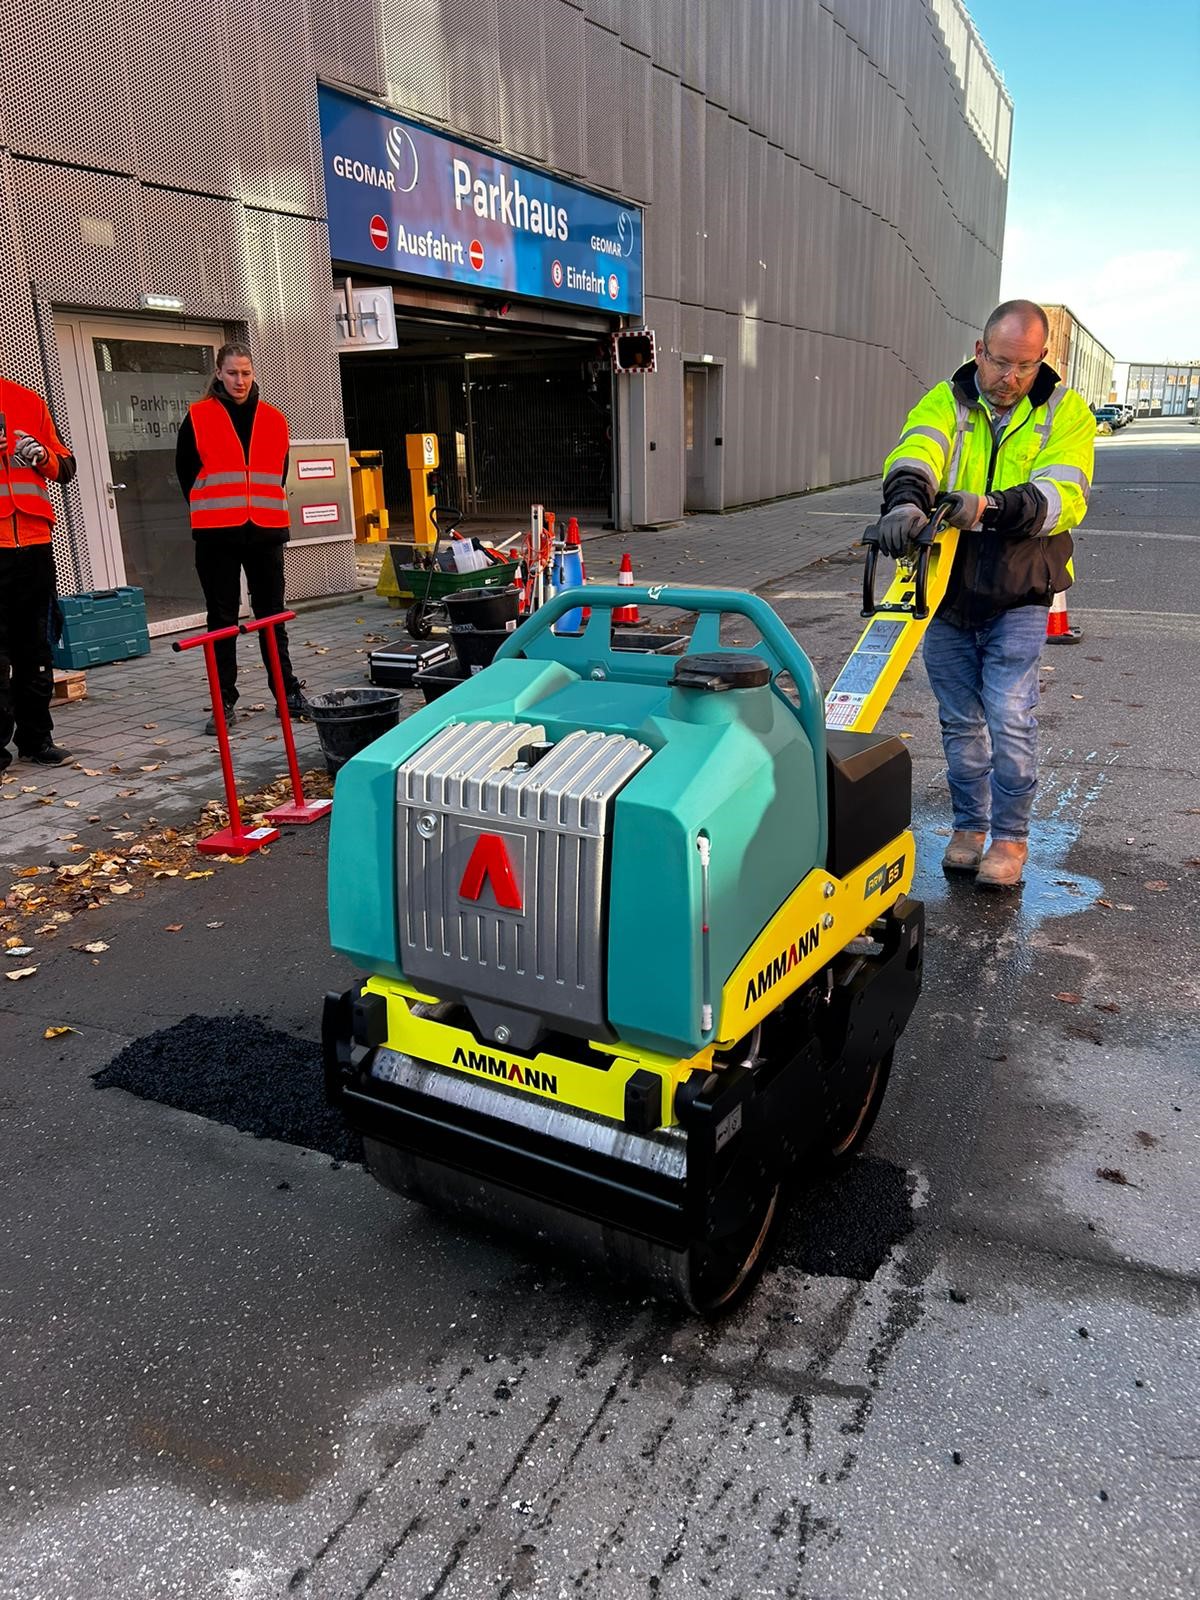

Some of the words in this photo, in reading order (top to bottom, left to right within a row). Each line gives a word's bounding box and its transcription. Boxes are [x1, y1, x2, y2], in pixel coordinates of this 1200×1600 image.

[333, 155, 397, 192] GEOMAR
[452, 158, 569, 241] Parkhaus
[397, 224, 464, 265] Ausfahrt
[590, 235, 622, 258] GEOMAR
[566, 265, 606, 295] Einfahrt
[888, 863, 900, 884] 65
[743, 922, 820, 1012] AMMANN
[452, 1046, 558, 1095] AMMANN
